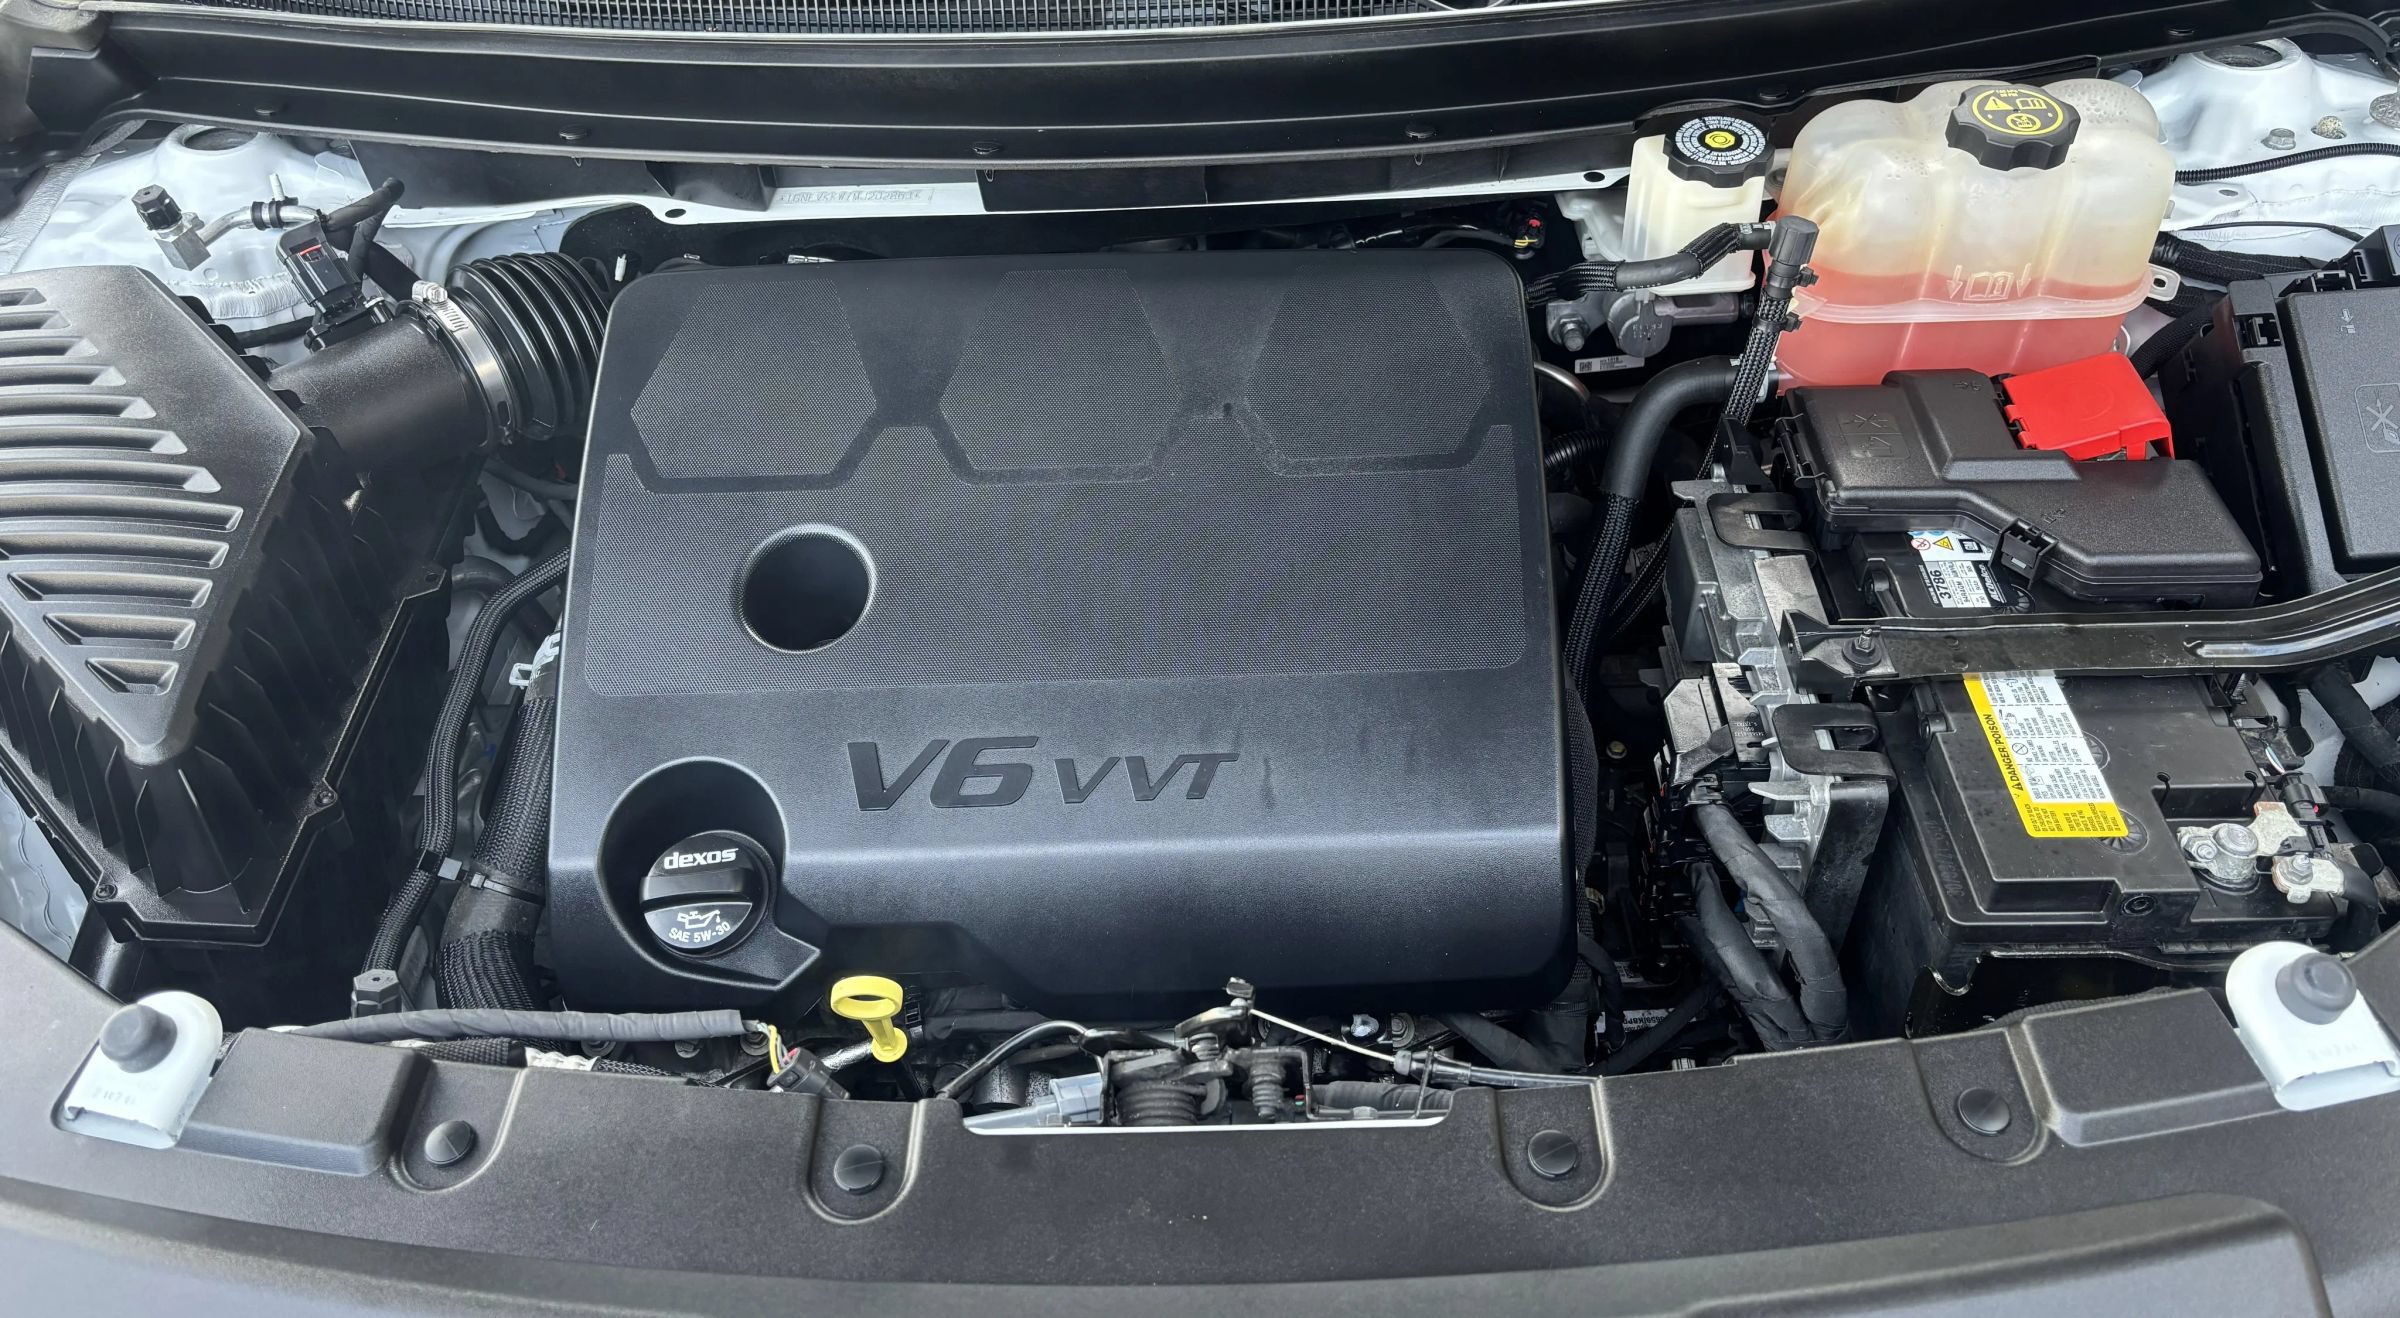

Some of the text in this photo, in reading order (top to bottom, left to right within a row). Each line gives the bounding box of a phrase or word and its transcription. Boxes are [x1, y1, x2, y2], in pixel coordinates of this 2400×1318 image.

[1929, 569, 1952, 600] 3786
[1983, 713, 2020, 782] DANGER/POISON
[847, 735, 1241, 811] V6 VVT
[663, 847, 739, 870] dexos
[668, 921, 731, 943] SAE 5W-30
